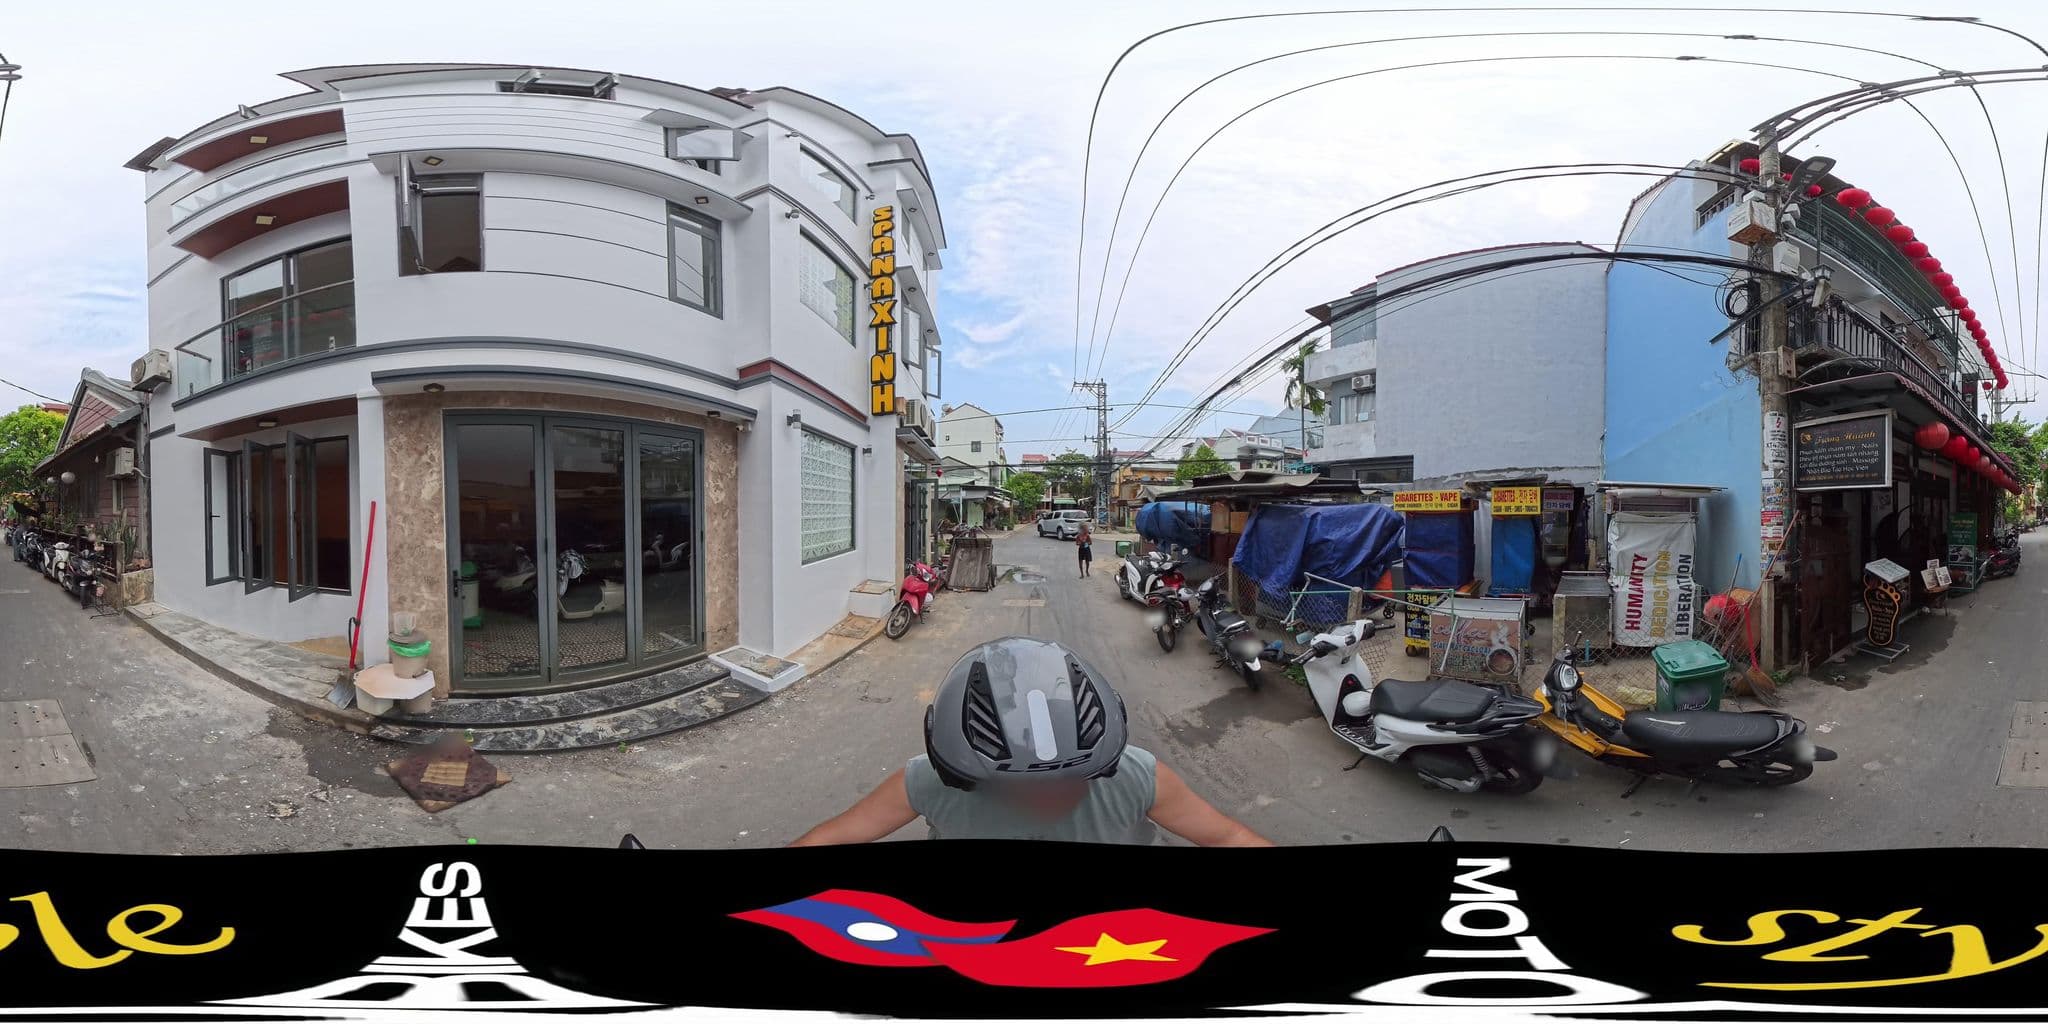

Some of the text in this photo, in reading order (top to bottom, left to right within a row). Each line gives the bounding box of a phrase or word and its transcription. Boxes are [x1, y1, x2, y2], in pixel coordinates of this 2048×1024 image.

[870, 205, 897, 416] SPANAXINH
[1395, 493, 1433, 502] CIGARETTES
[1440, 492, 1458, 501] VAPE
[1625, 553, 1648, 631] HUMANITY
[1649, 550, 1672, 638] DEDICTION
[1674, 554, 1692, 636] LIBERATION
